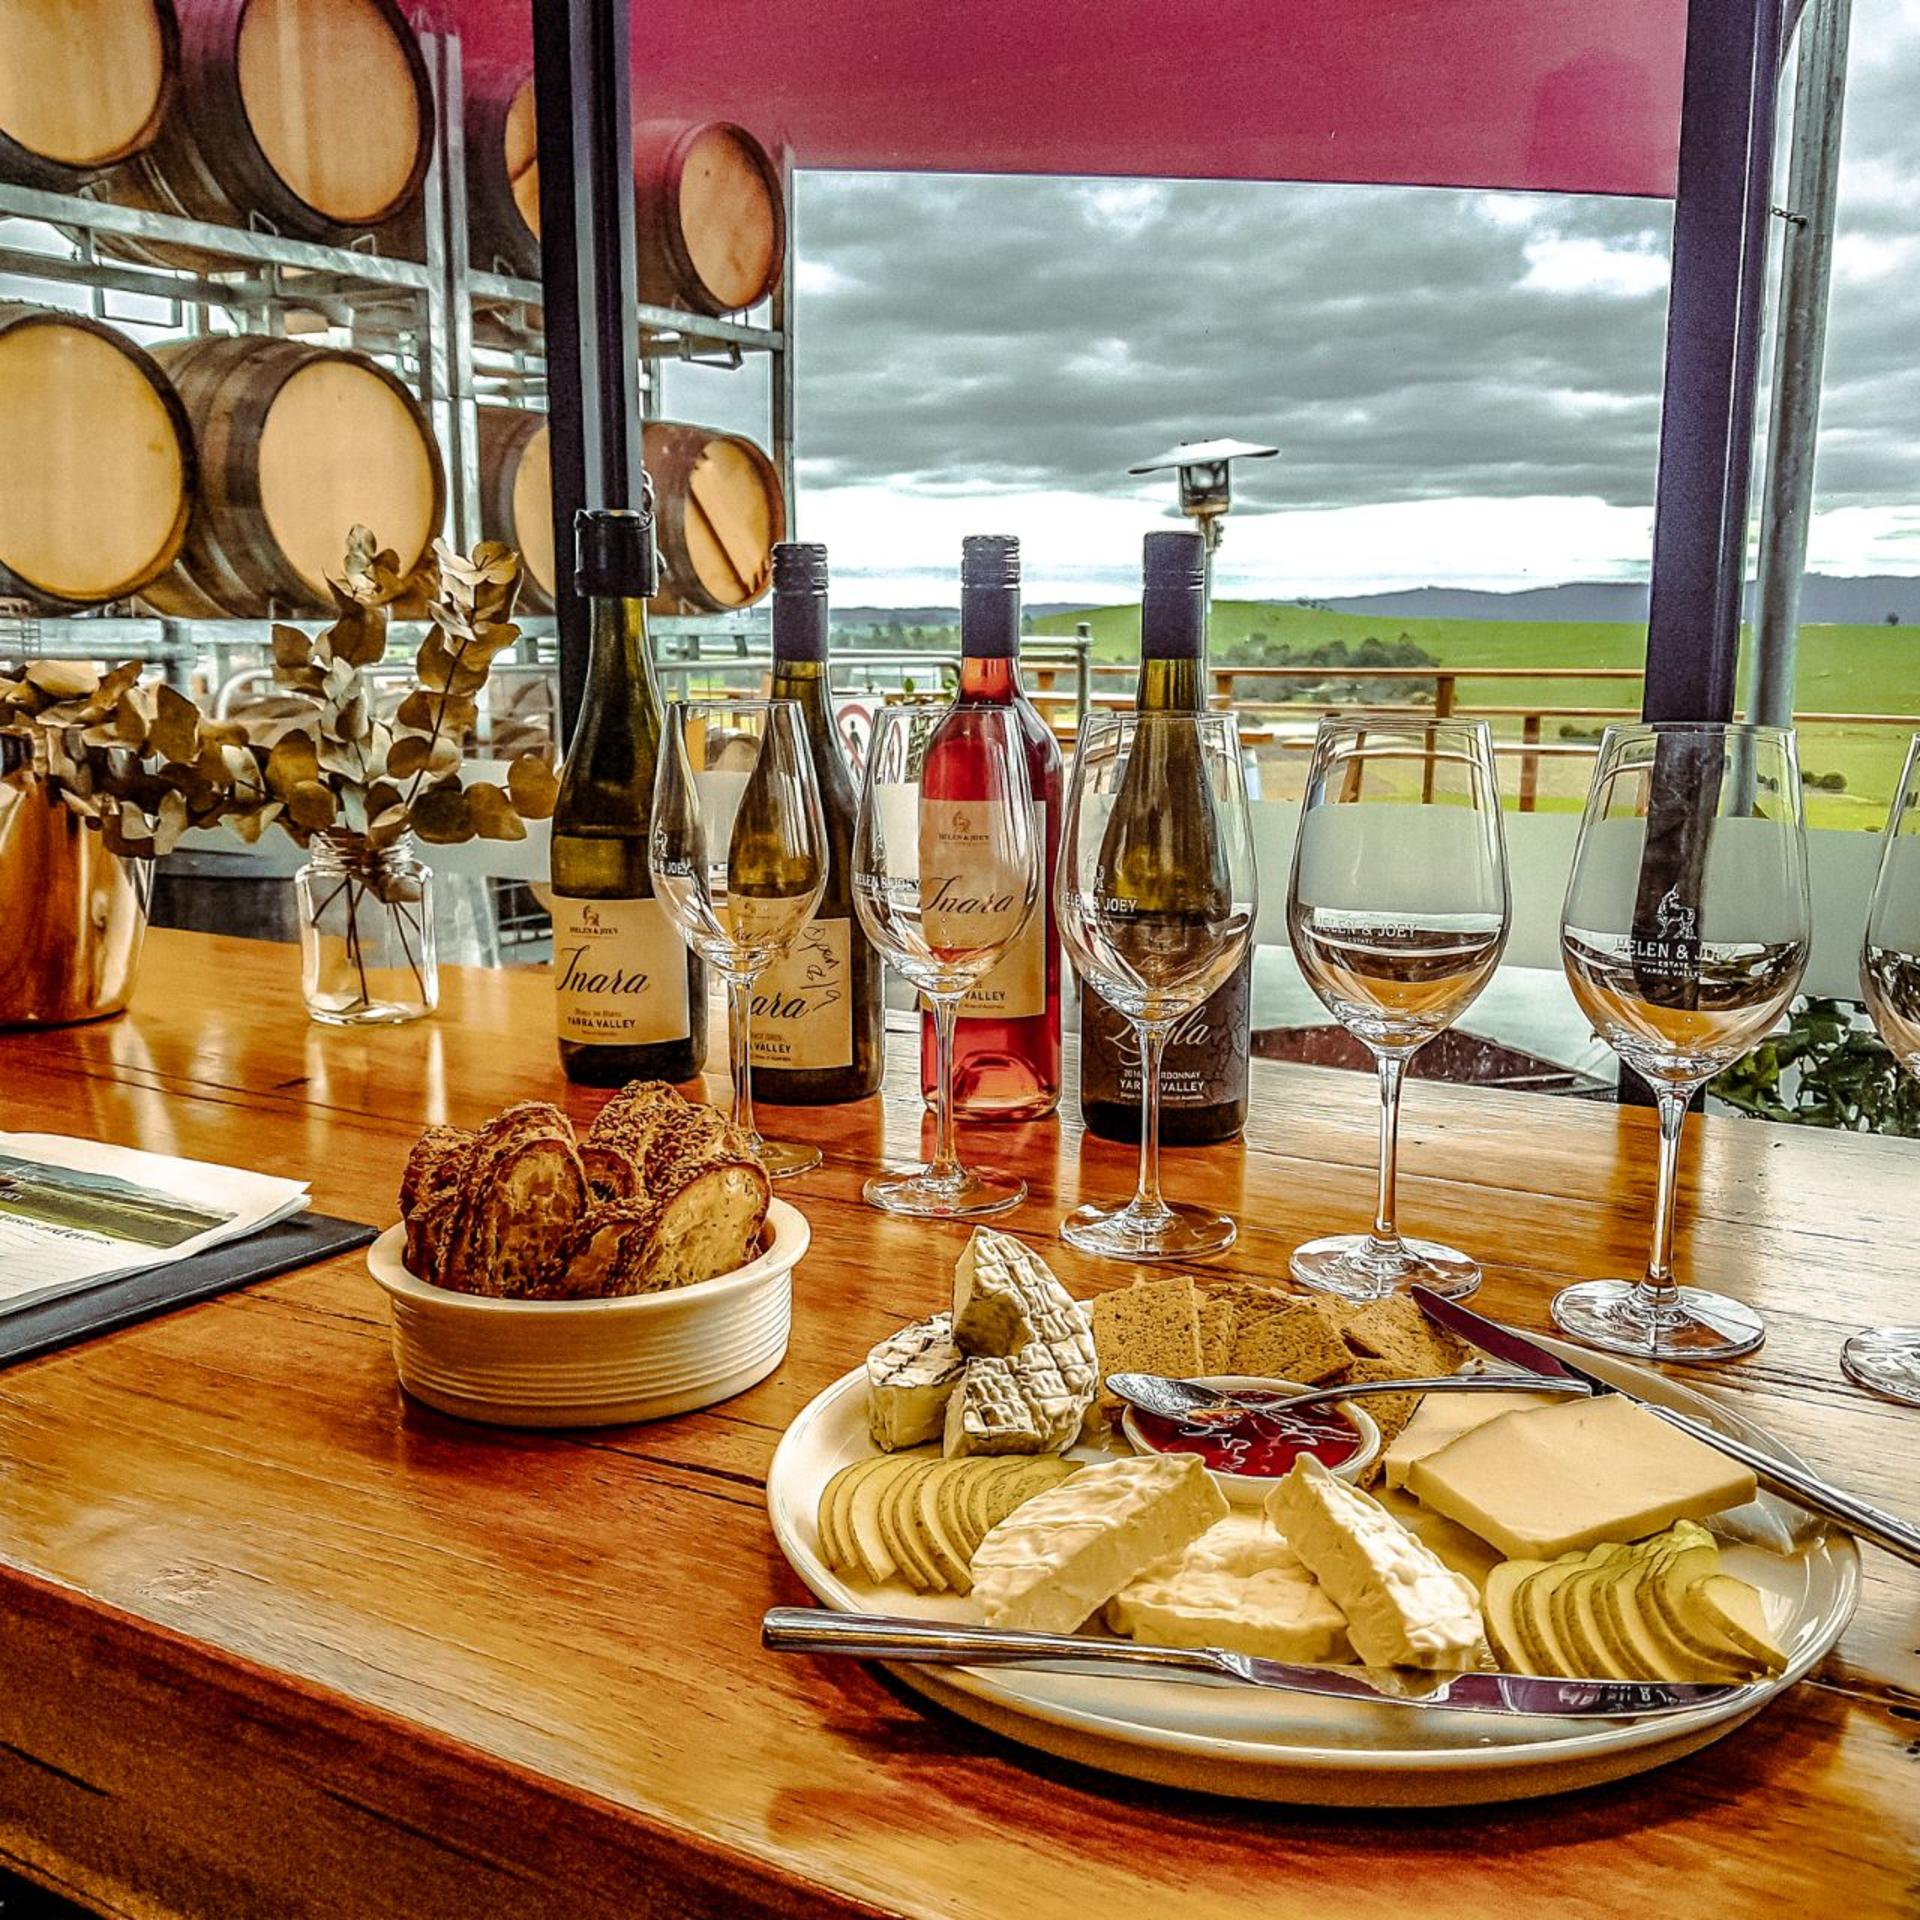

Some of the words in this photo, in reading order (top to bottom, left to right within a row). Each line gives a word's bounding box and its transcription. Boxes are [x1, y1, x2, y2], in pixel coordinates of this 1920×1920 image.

[666, 861, 691, 875] JOEY
[924, 875, 1015, 915] Inara
[1103, 898, 1138, 913] JOEY
[1314, 917, 1355, 936] HELEN
[1361, 923, 1374, 936] &
[1377, 922, 1418, 939] JOEY
[1347, 937, 1376, 946] ESTATE
[1615, 938, 1669, 959] HELEN
[1675, 943, 1689, 960] &
[555, 944, 651, 995] Inara
[1657, 960, 1690, 970] ESTATE
[1641, 966, 1669, 976] YARRA
[1672, 968, 1706, 979] VALLEY
[964, 991, 1006, 1001] VALLEY
[750, 992, 811, 1020] ara
[567, 1016, 594, 1028] YARRA
[596, 1019, 636, 1029] VALLEY
[754, 1043, 792, 1054] VALLEY
[1160, 1071, 1200, 1080] RDONNAY
[1119, 1079, 1141, 1091] YAR
[1160, 1081, 1205, 1092] VALLEY
